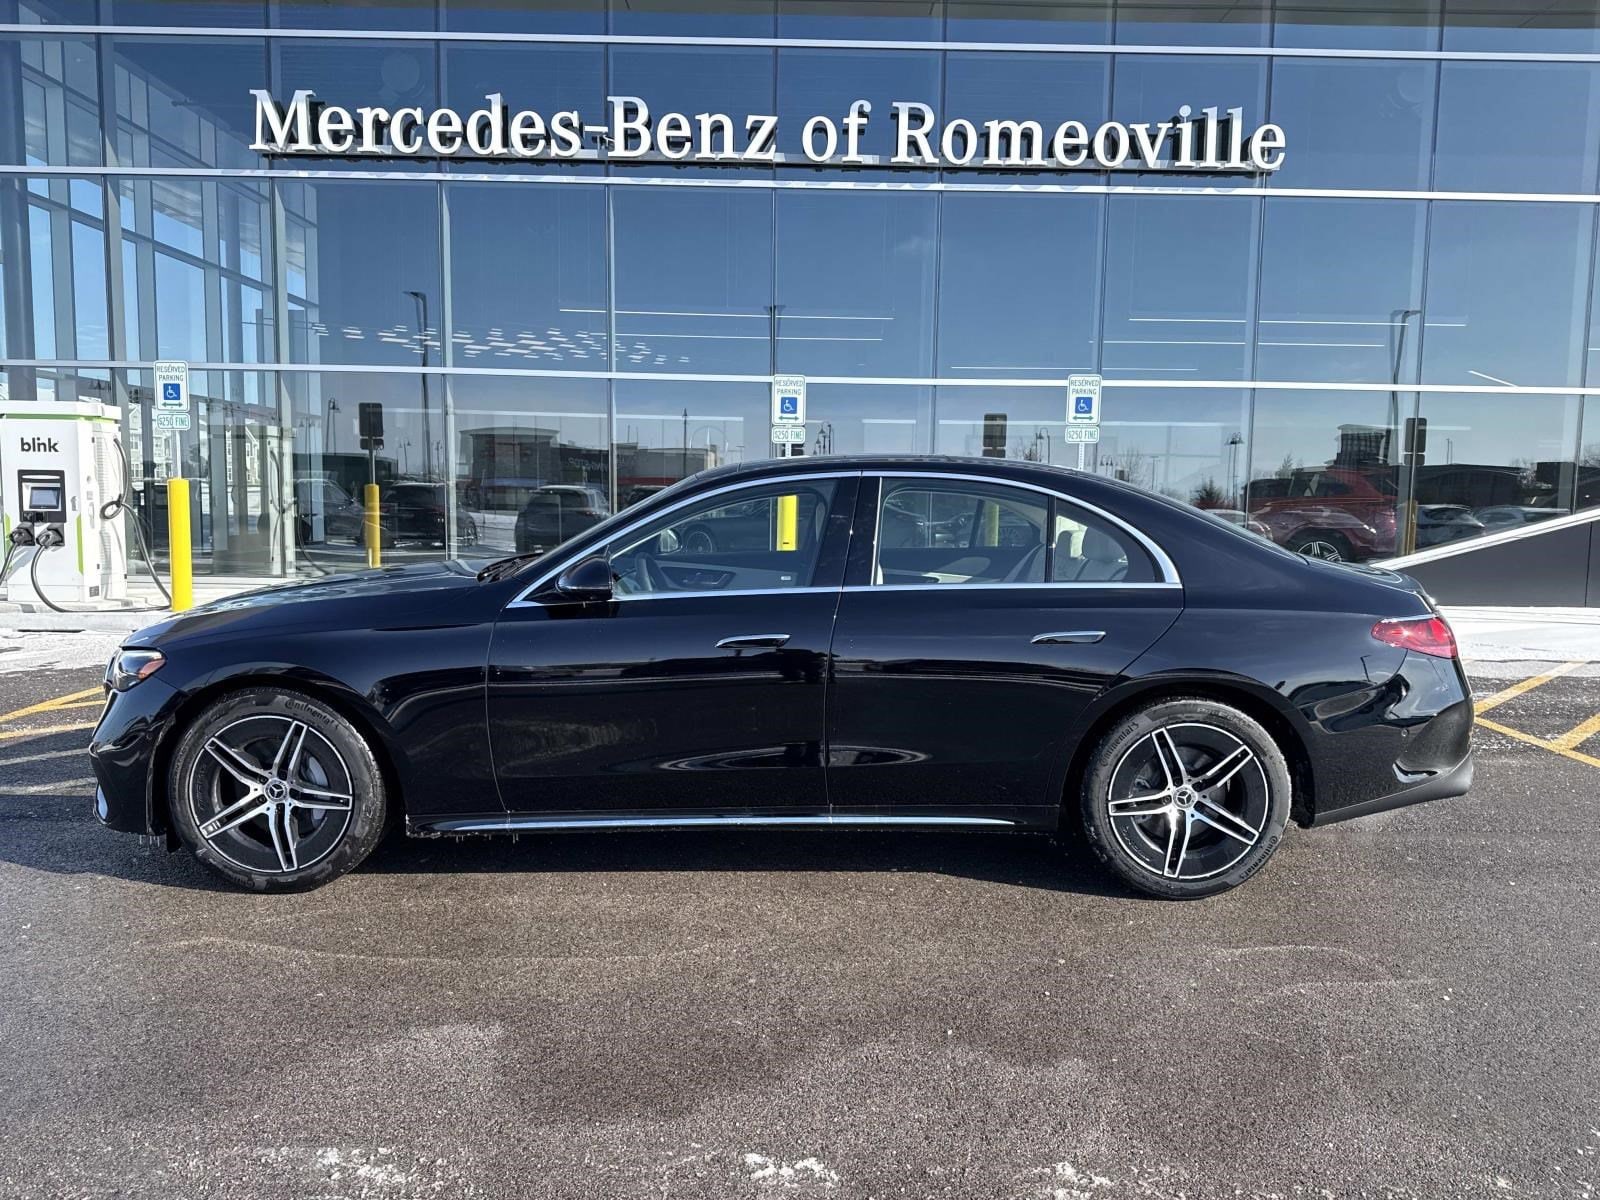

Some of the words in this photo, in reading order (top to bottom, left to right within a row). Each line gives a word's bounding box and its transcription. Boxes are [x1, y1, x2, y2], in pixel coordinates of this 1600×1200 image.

[249, 88, 777, 161] Mercedes-Benz
[802, 99, 872, 163] of
[891, 100, 1286, 171] Romeoville
[156, 365, 185, 373] RESERVED
[775, 379, 804, 387] RESERVED
[1070, 379, 1099, 387] RESERVED
[776, 388, 802, 396] PARKING
[158, 417, 174, 426] $250
[175, 417, 189, 427] FINE
[790, 430, 804, 440] FINE
[1067, 430, 1083, 440] $250
[1084, 430, 1097, 440] FINE
[20, 437, 59, 453] blink
